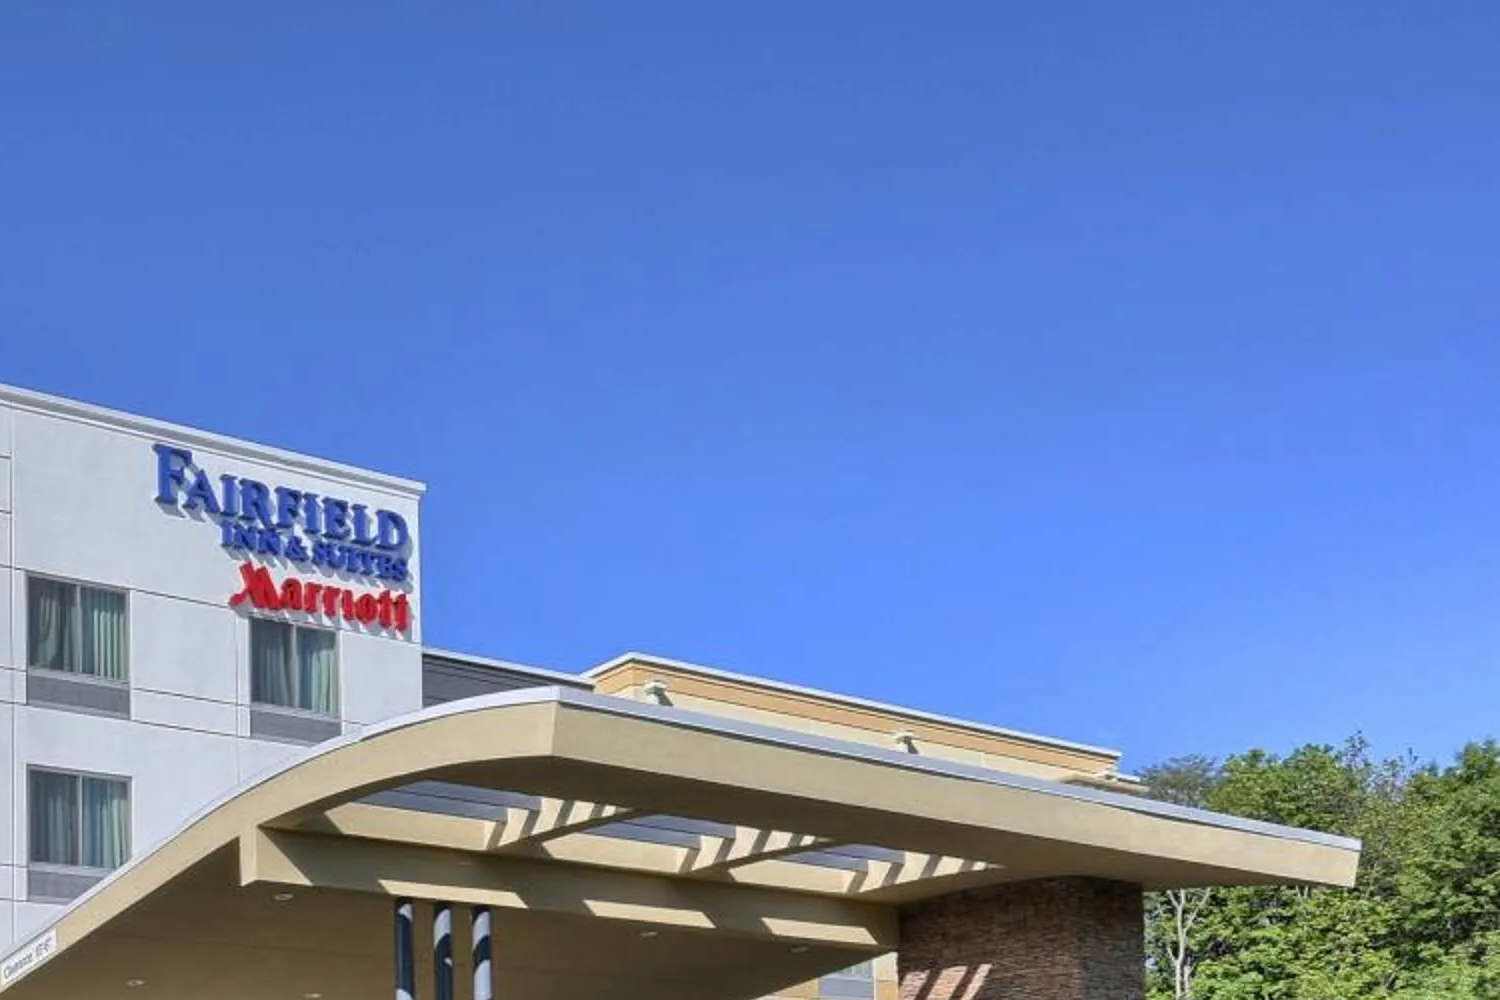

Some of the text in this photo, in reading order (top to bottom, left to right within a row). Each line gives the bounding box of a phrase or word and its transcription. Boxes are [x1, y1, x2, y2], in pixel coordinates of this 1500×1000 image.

[153, 443, 409, 550] FAIRFIELD
[220, 519, 408, 582] INN & SUITES
[229, 561, 409, 632] Marriott
